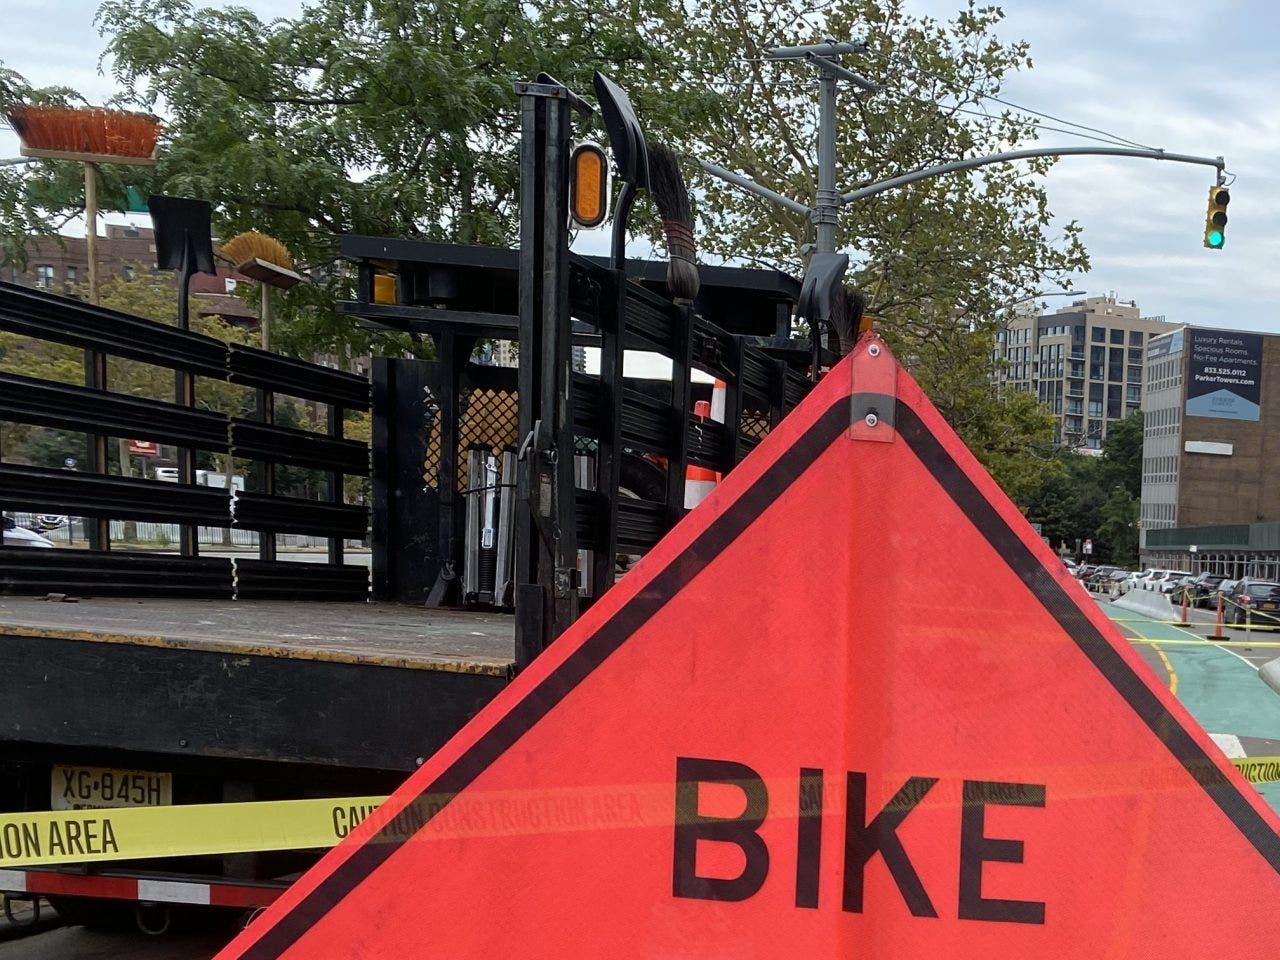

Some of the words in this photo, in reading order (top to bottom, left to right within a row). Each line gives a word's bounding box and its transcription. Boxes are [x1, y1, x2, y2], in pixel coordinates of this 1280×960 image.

[1195, 374, 1255, 386] ParkerTowers.com
[1204, 366, 1246, 377] 833.525.0112
[48, 819, 119, 856] AREA
[672, 756, 1046, 925] BIKE
